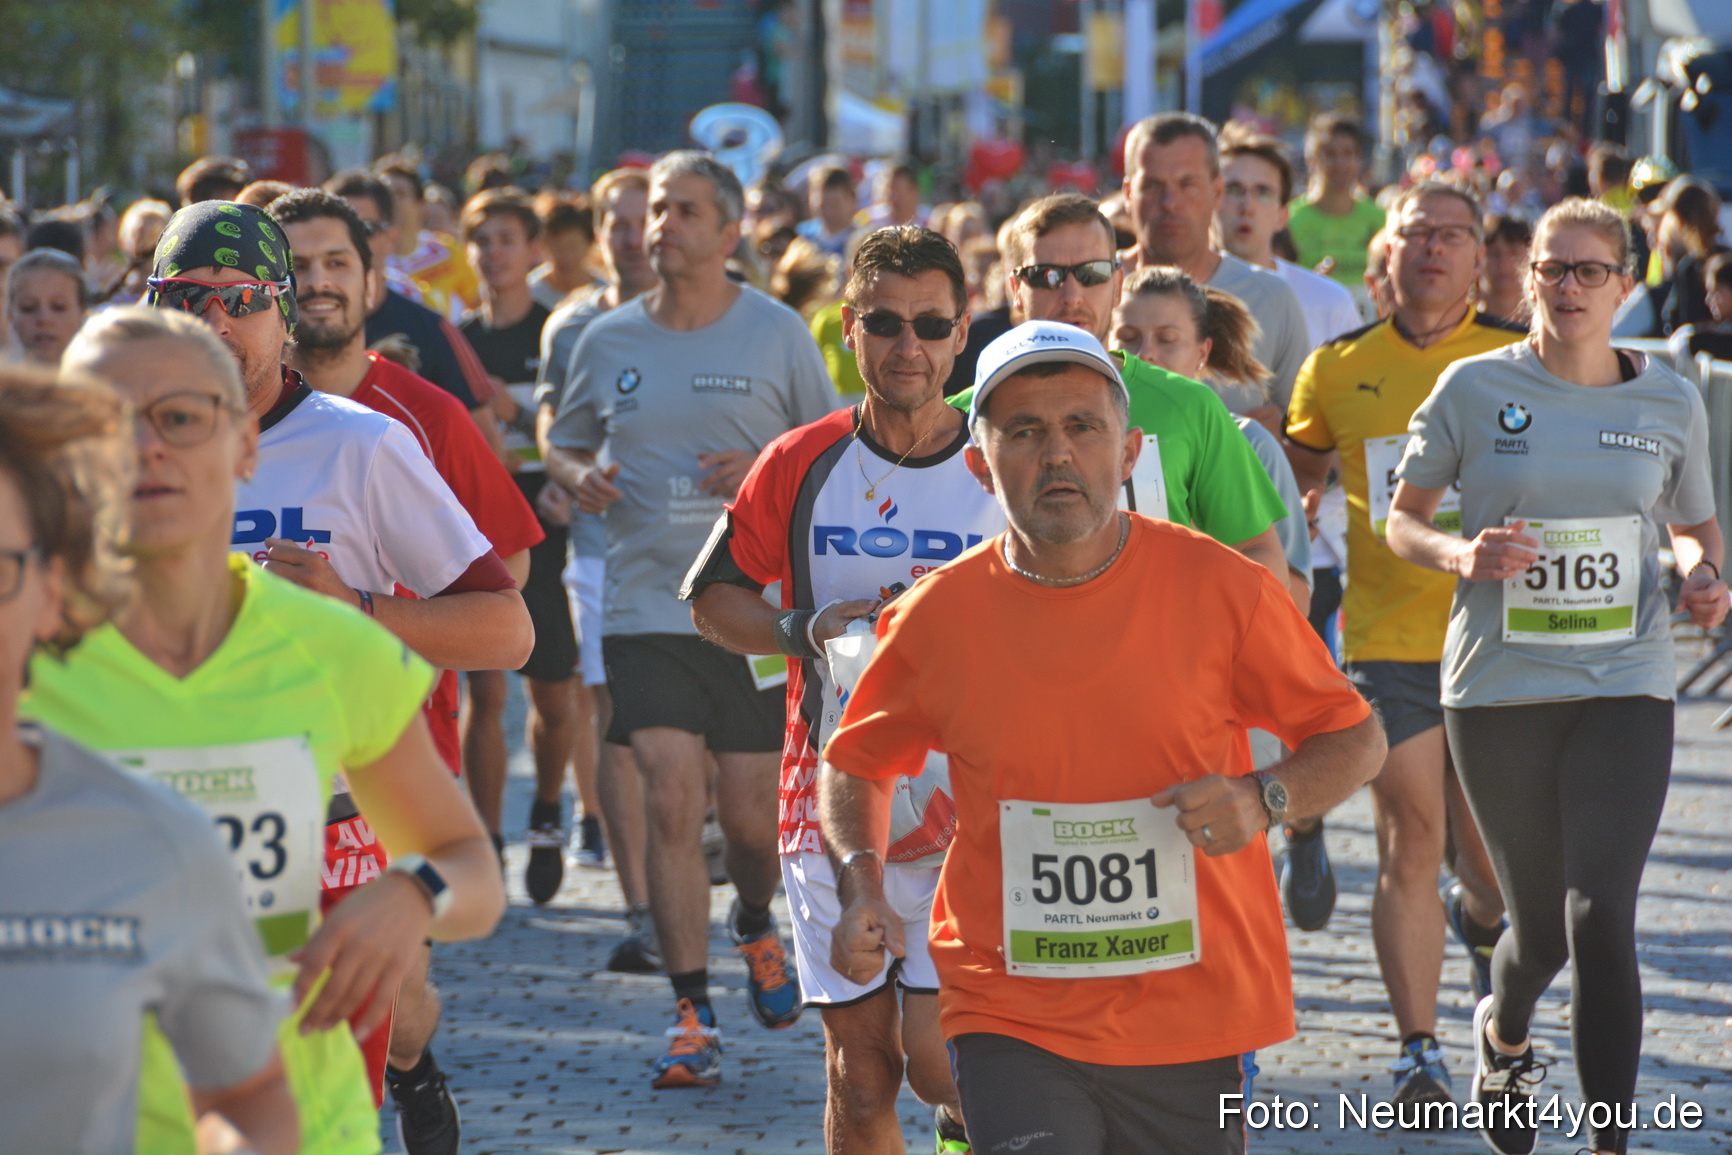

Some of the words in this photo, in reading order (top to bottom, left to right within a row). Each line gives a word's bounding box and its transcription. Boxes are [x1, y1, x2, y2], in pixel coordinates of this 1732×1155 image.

[1495, 438, 1529, 449] PARTL
[1600, 430, 1660, 456] BOCK
[1544, 529, 1601, 544] BOCK
[1525, 552, 1620, 591] 5163
[1548, 613, 1597, 630] Selina
[1053, 818, 1137, 839] BOCK
[1032, 848, 1158, 905] 5081
[1044, 913, 1083, 924] PARTL
[1086, 911, 1142, 924] Neumarkt
[1035, 937, 1098, 958] Franz
[1105, 934, 1169, 956] Xaver
